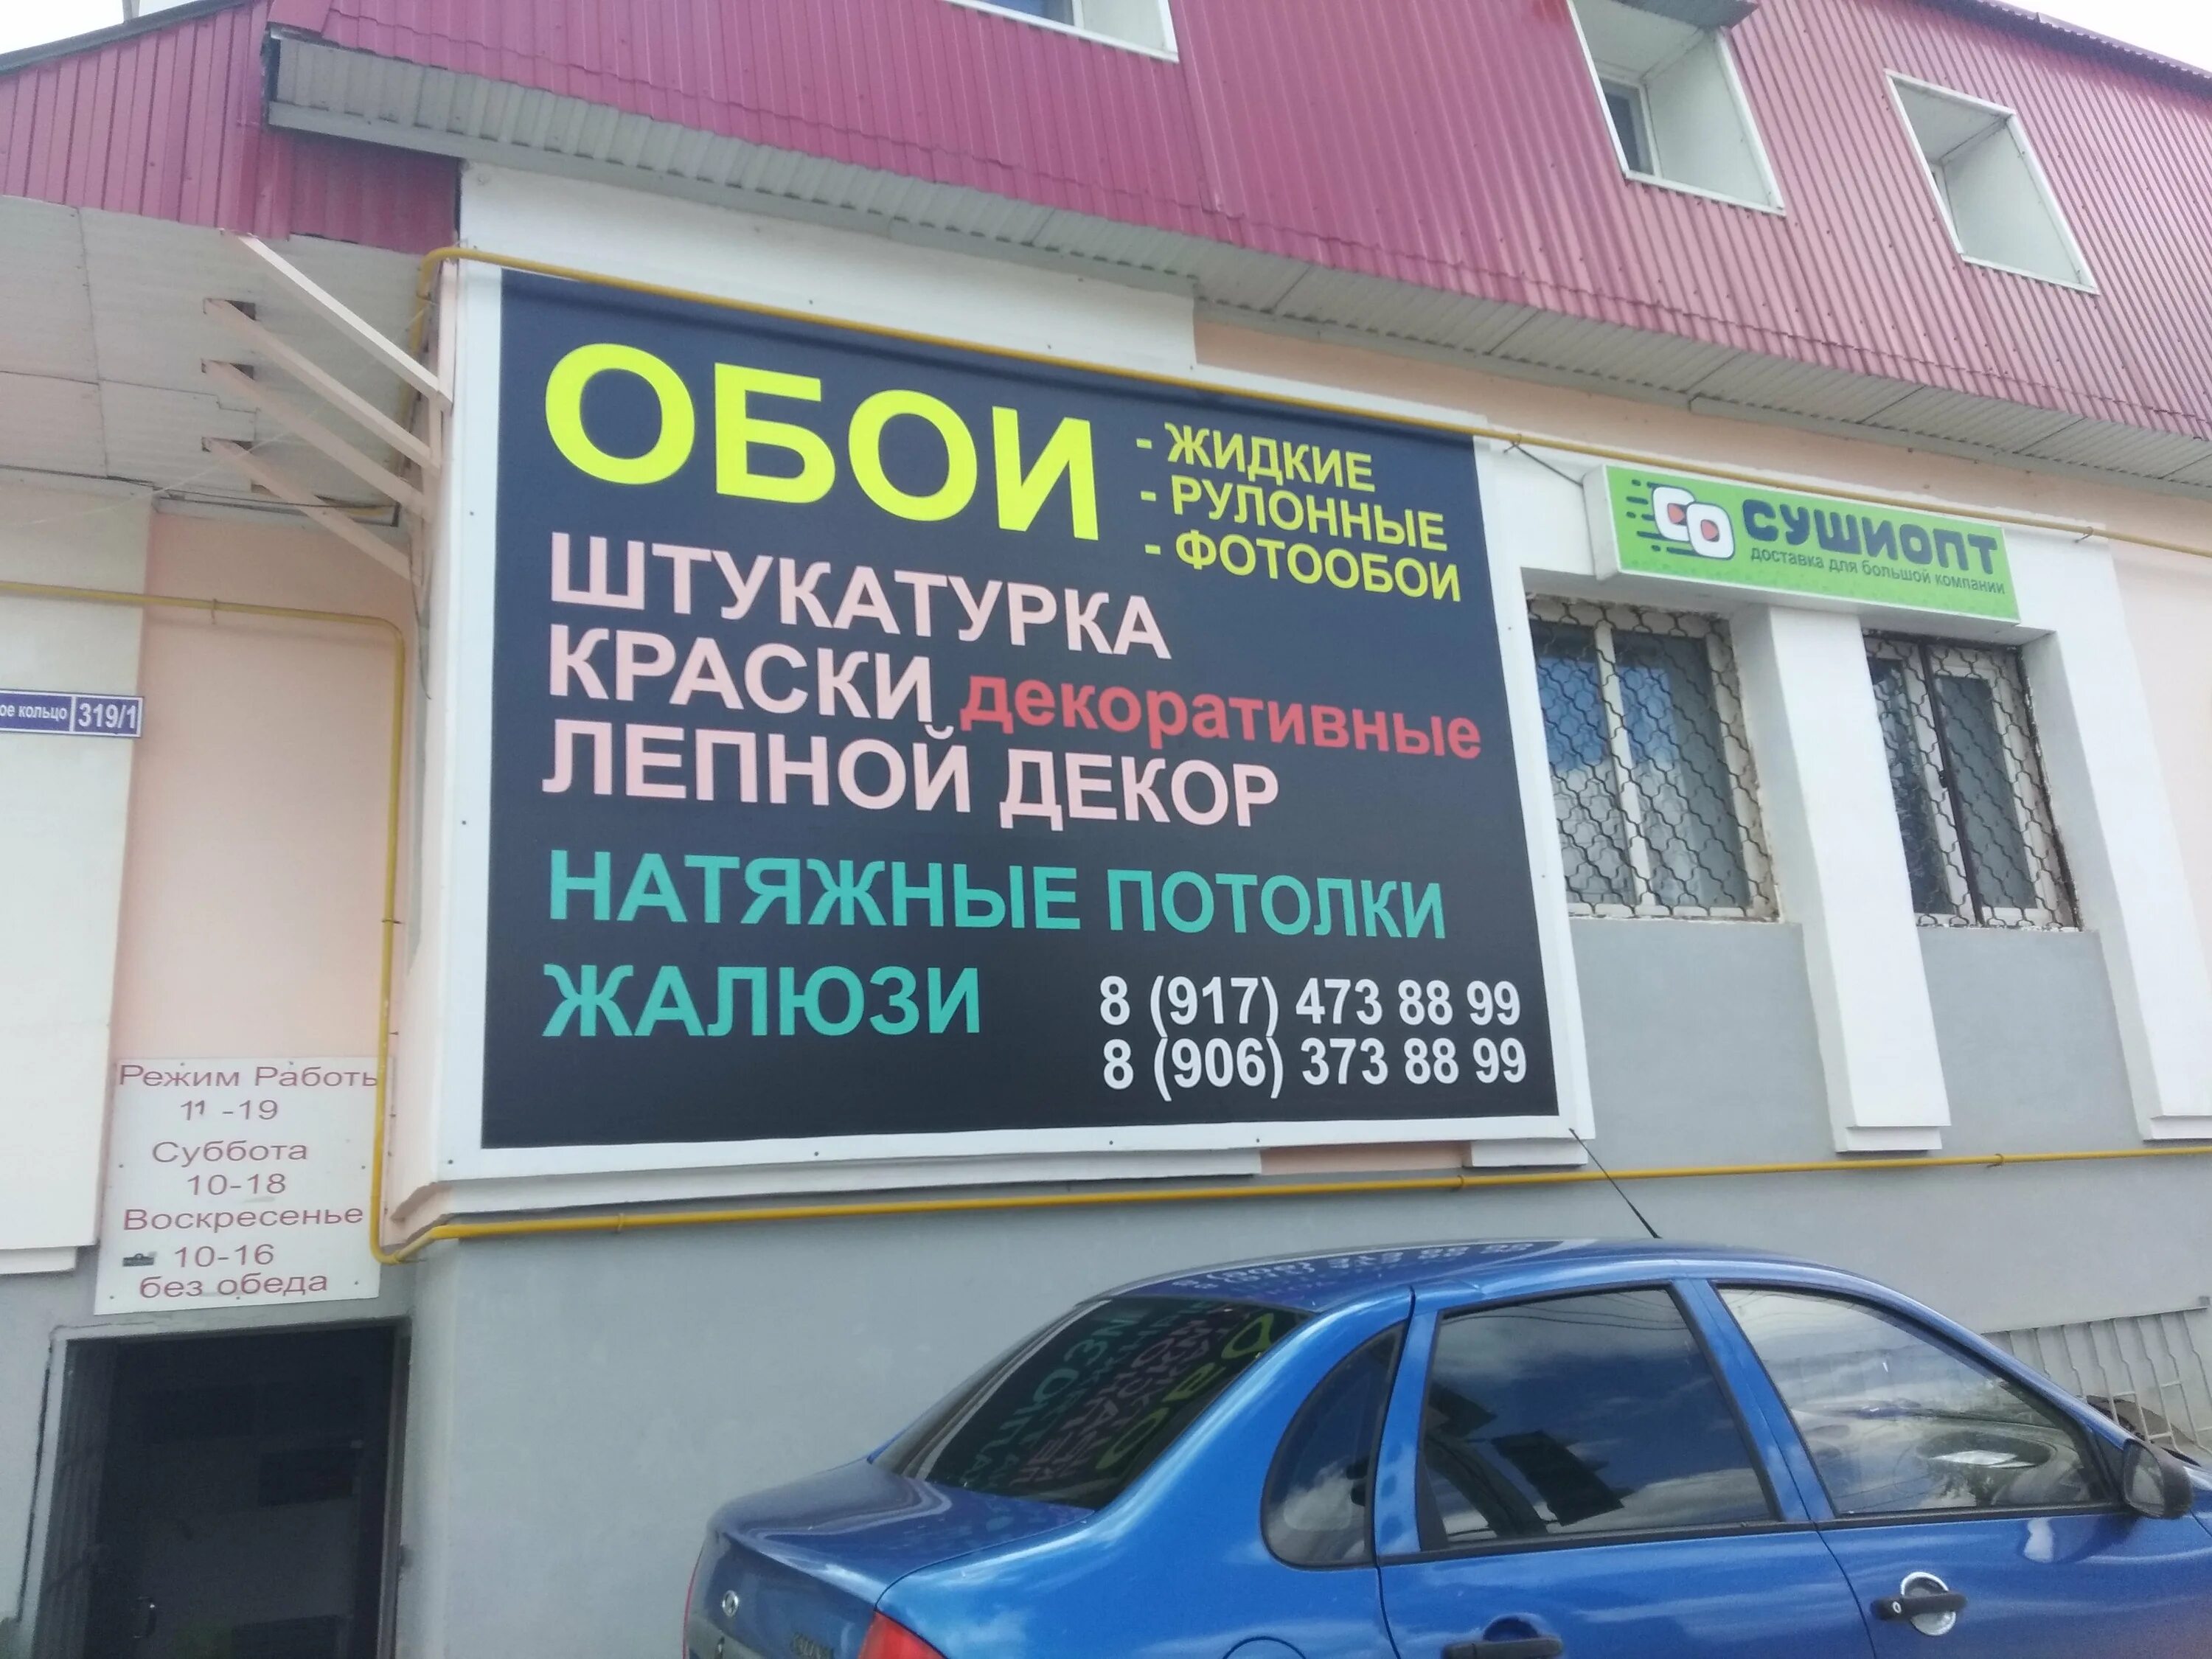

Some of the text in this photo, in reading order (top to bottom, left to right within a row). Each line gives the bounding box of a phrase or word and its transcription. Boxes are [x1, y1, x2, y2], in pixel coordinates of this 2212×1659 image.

[546, 343, 1099, 541] ОБОИ
[1164, 422, 1376, 493] ЖИДКИЕ
[1171, 475, 1447, 552] РУЛОННЫЕ
[1742, 498, 1998, 575] СУШИОПТ
[551, 531, 1172, 660] ШТУКАТУРКА
[1175, 529, 1461, 602] ФОТООБОИ
[1751, 547, 2006, 594] доставка для большой компании
[18, 706, 68, 722] кольцо
[78, 703, 137, 728] 319/1
[549, 623, 1482, 759] КРАСКИ декоративные
[542, 719, 1279, 832] ЛЕПНОЙ ДЕКОР
[549, 849, 1446, 939] НАТЯЖНЫЕ ПОТОЛКИ
[542, 964, 980, 1037] ЖАЛЮЗИ
[1099, 975, 1521, 1038] 8 (917) 473 88 99
[119, 1064, 240, 1087] Режим
[1103, 1037, 1527, 1102] 8 (906) 373 88 99
[152, 1140, 308, 1167] Суббота
[187, 1173, 287, 1196] 10-18
[123, 1207, 364, 1233] Воскресенье
[139, 1272, 328, 1298] без обеда
[174, 1244, 274, 1268] 10-16
